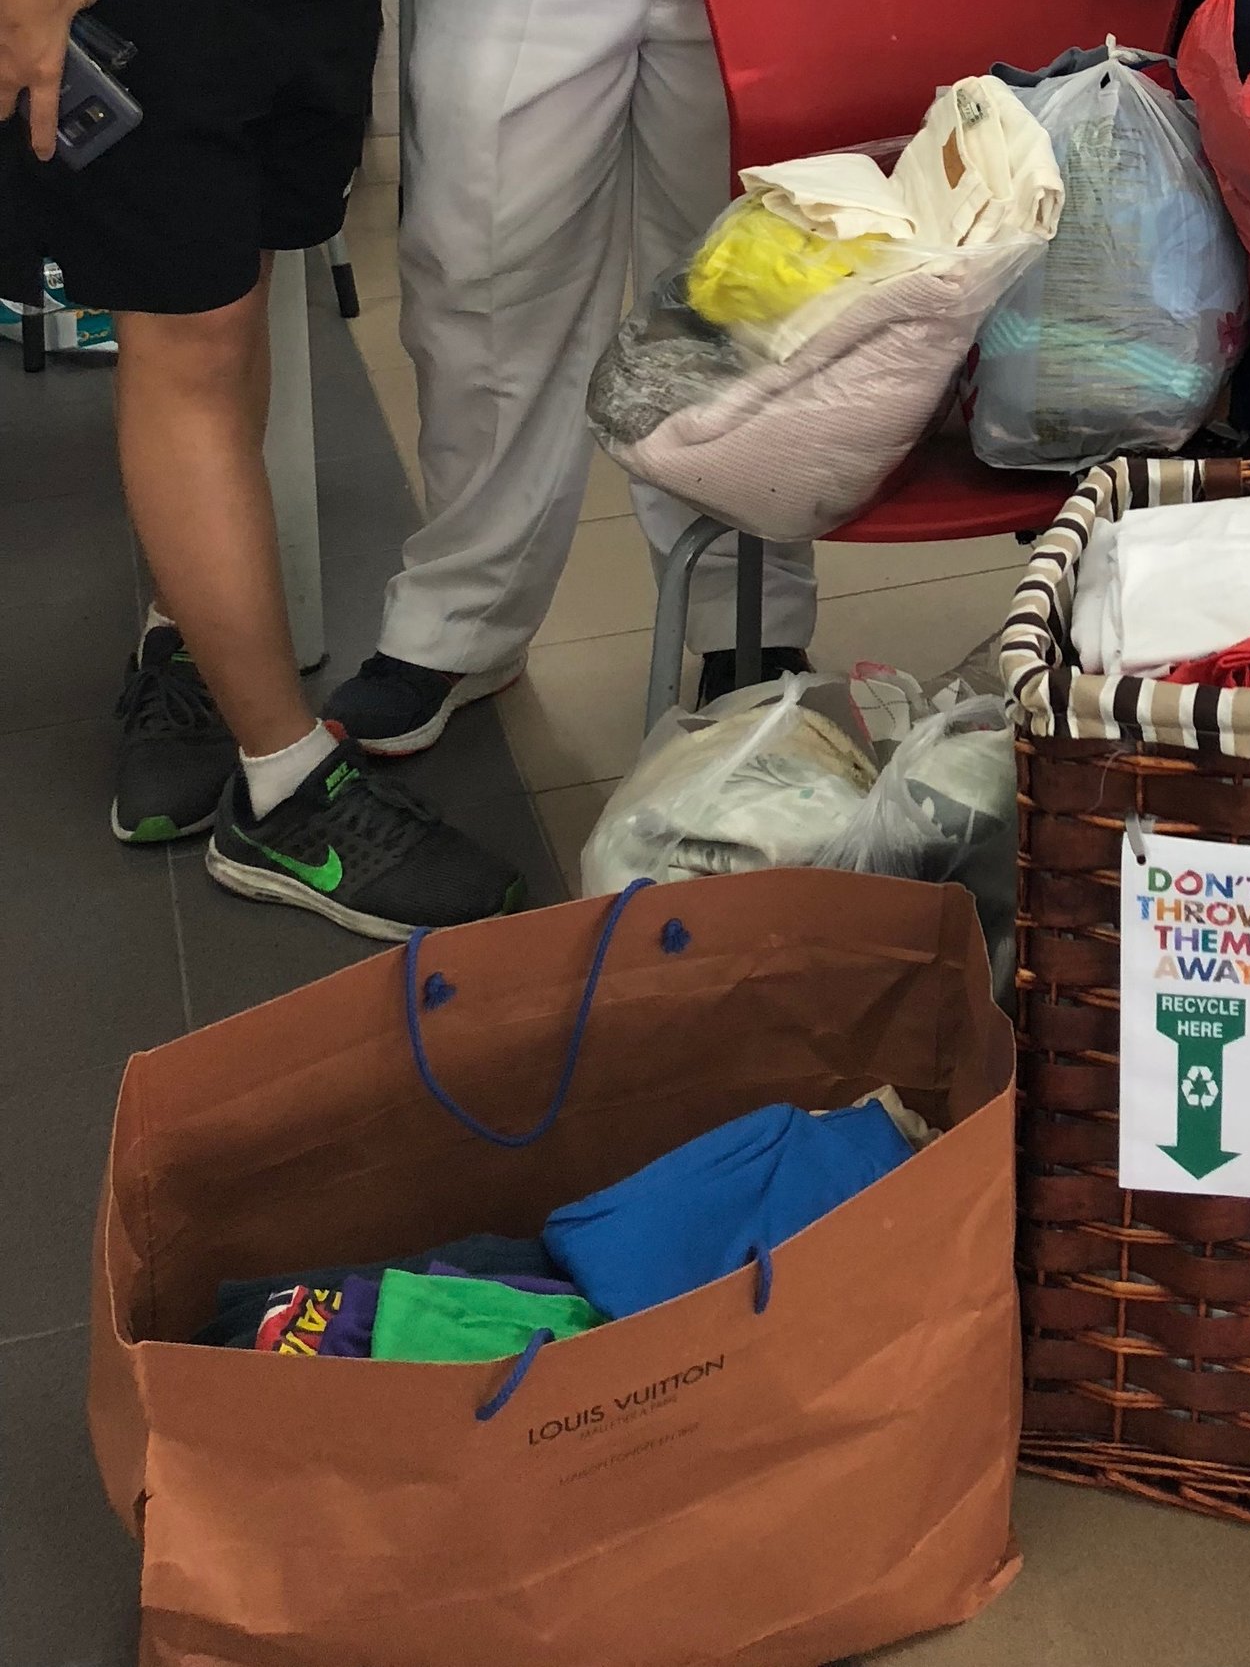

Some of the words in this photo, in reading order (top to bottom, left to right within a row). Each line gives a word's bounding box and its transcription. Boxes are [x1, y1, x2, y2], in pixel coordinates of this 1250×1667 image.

[1162, 996, 1239, 1016] RECYCLE
[1177, 1020, 1223, 1038] HERE
[529, 1405, 605, 1446] LOUIS
[614, 1354, 725, 1410] VUITTON
